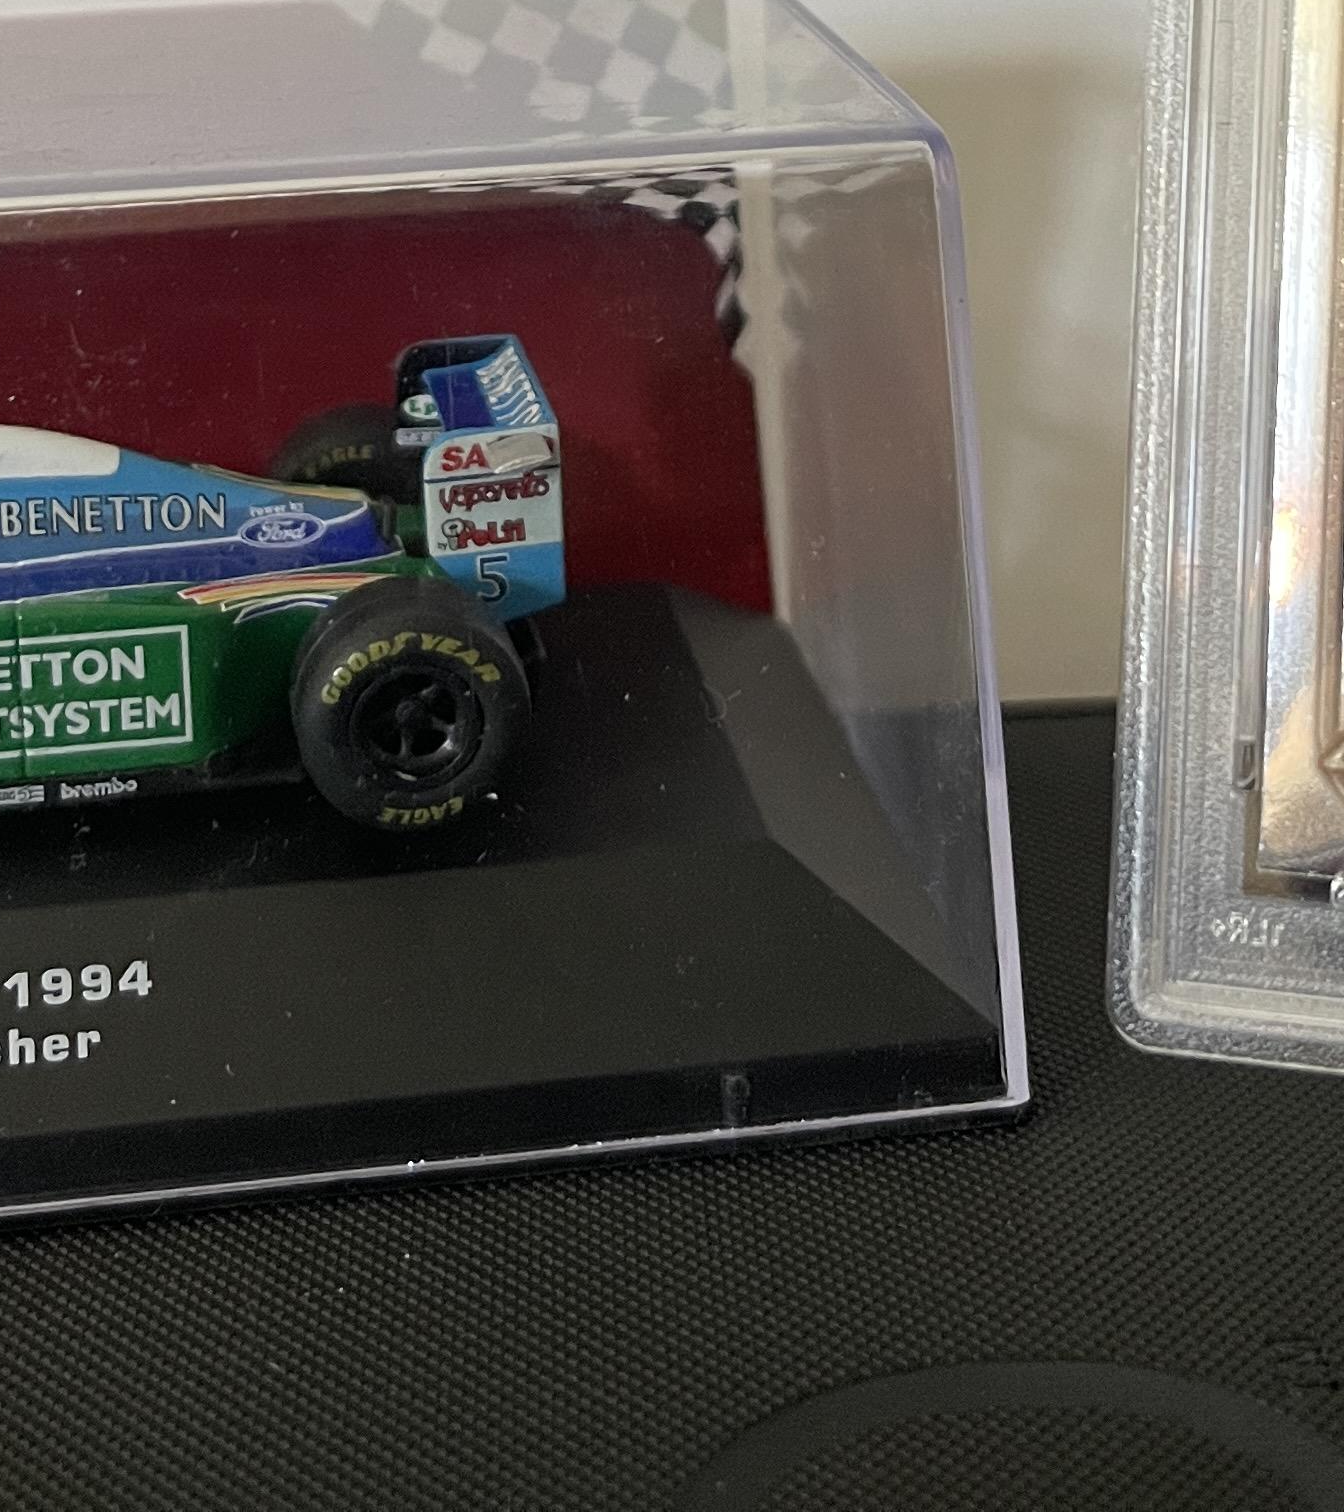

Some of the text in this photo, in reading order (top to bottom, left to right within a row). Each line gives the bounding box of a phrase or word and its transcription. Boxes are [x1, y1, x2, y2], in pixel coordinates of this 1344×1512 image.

[0, 493, 226, 537] BENETTON
[257, 520, 307, 543] Ford
[476, 553, 511, 603] 5
[60, 776, 138, 801] brembo
[377, 795, 464, 825] EAGLE
[2, 959, 154, 1010] 1994
